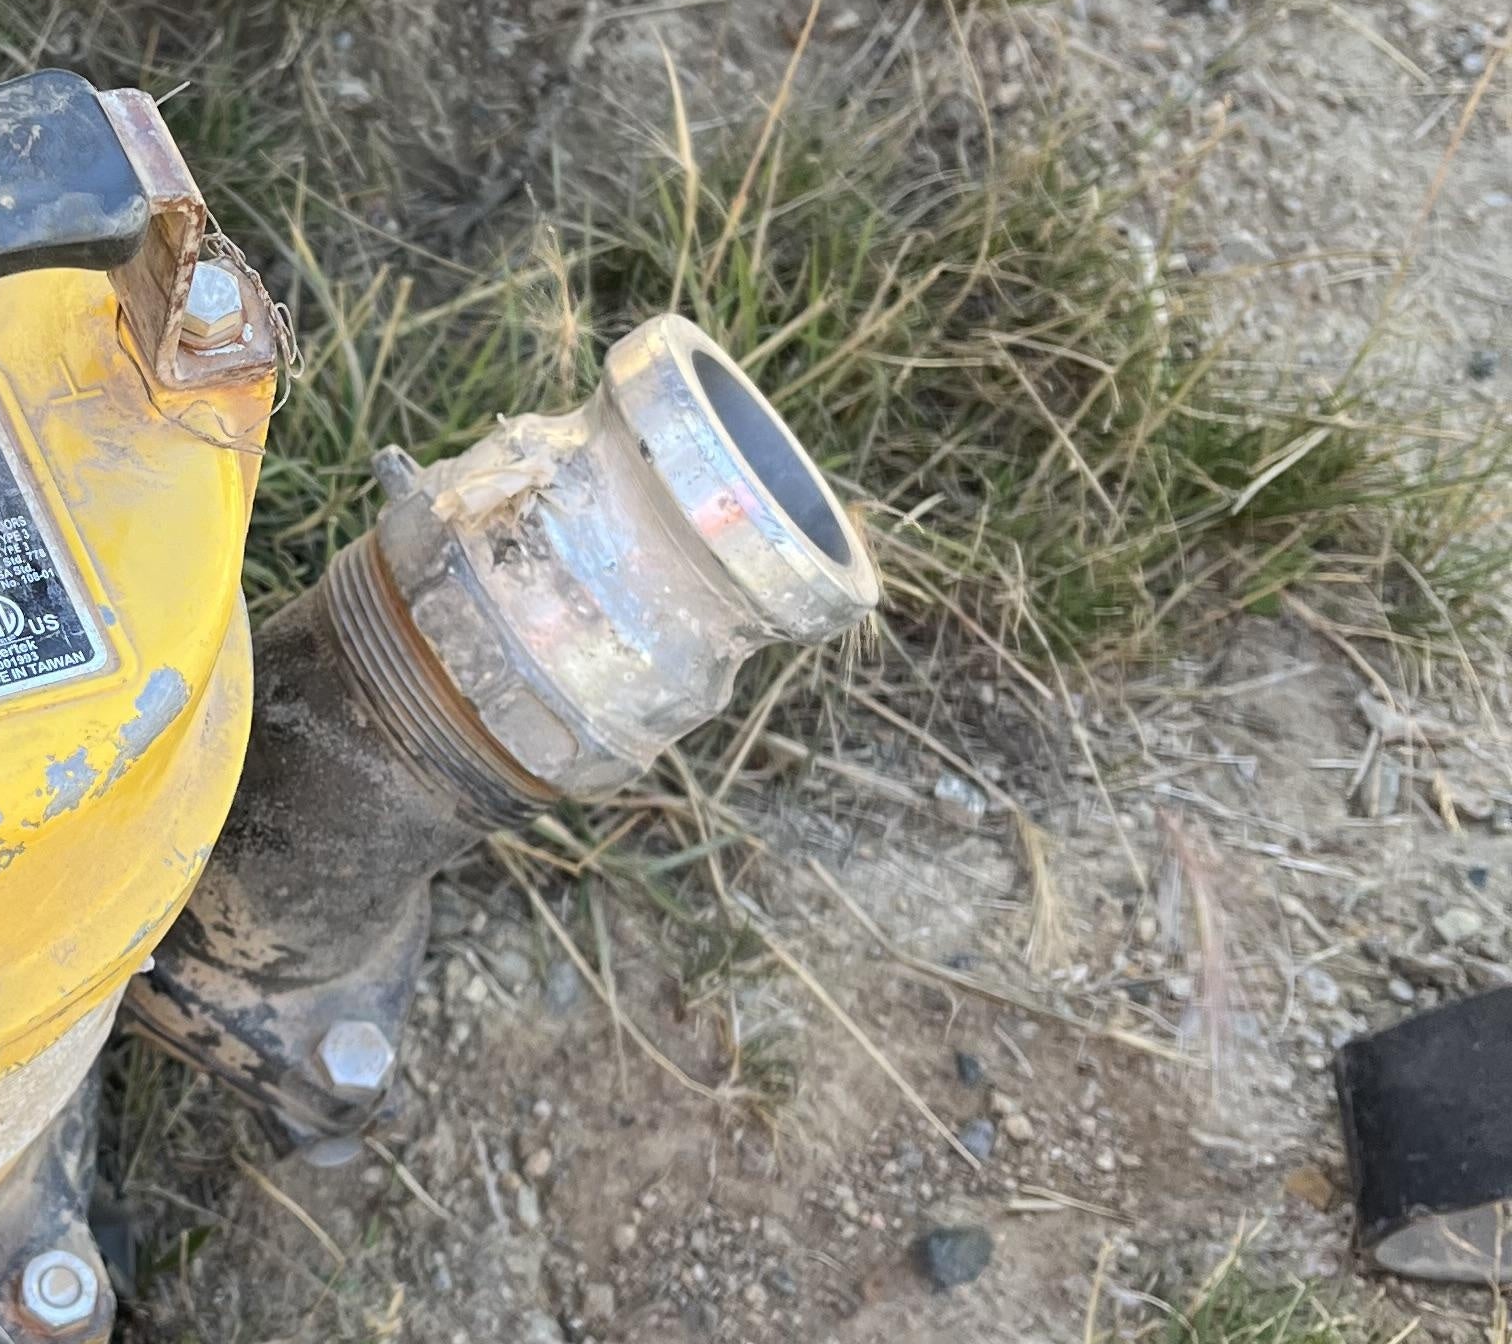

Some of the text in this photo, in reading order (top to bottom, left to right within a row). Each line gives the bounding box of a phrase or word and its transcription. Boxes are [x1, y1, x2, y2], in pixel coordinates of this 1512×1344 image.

[22, 529, 30, 538] 3
[22, 542, 30, 550] 3
[2, 554, 24, 566] Std.
[12, 564, 36, 574] Std.
[0, 578, 20, 588] No.
[28, 614, 62, 634] US
[10, 668, 28, 678] IN
[28, 652, 86, 674] TAIWAN
